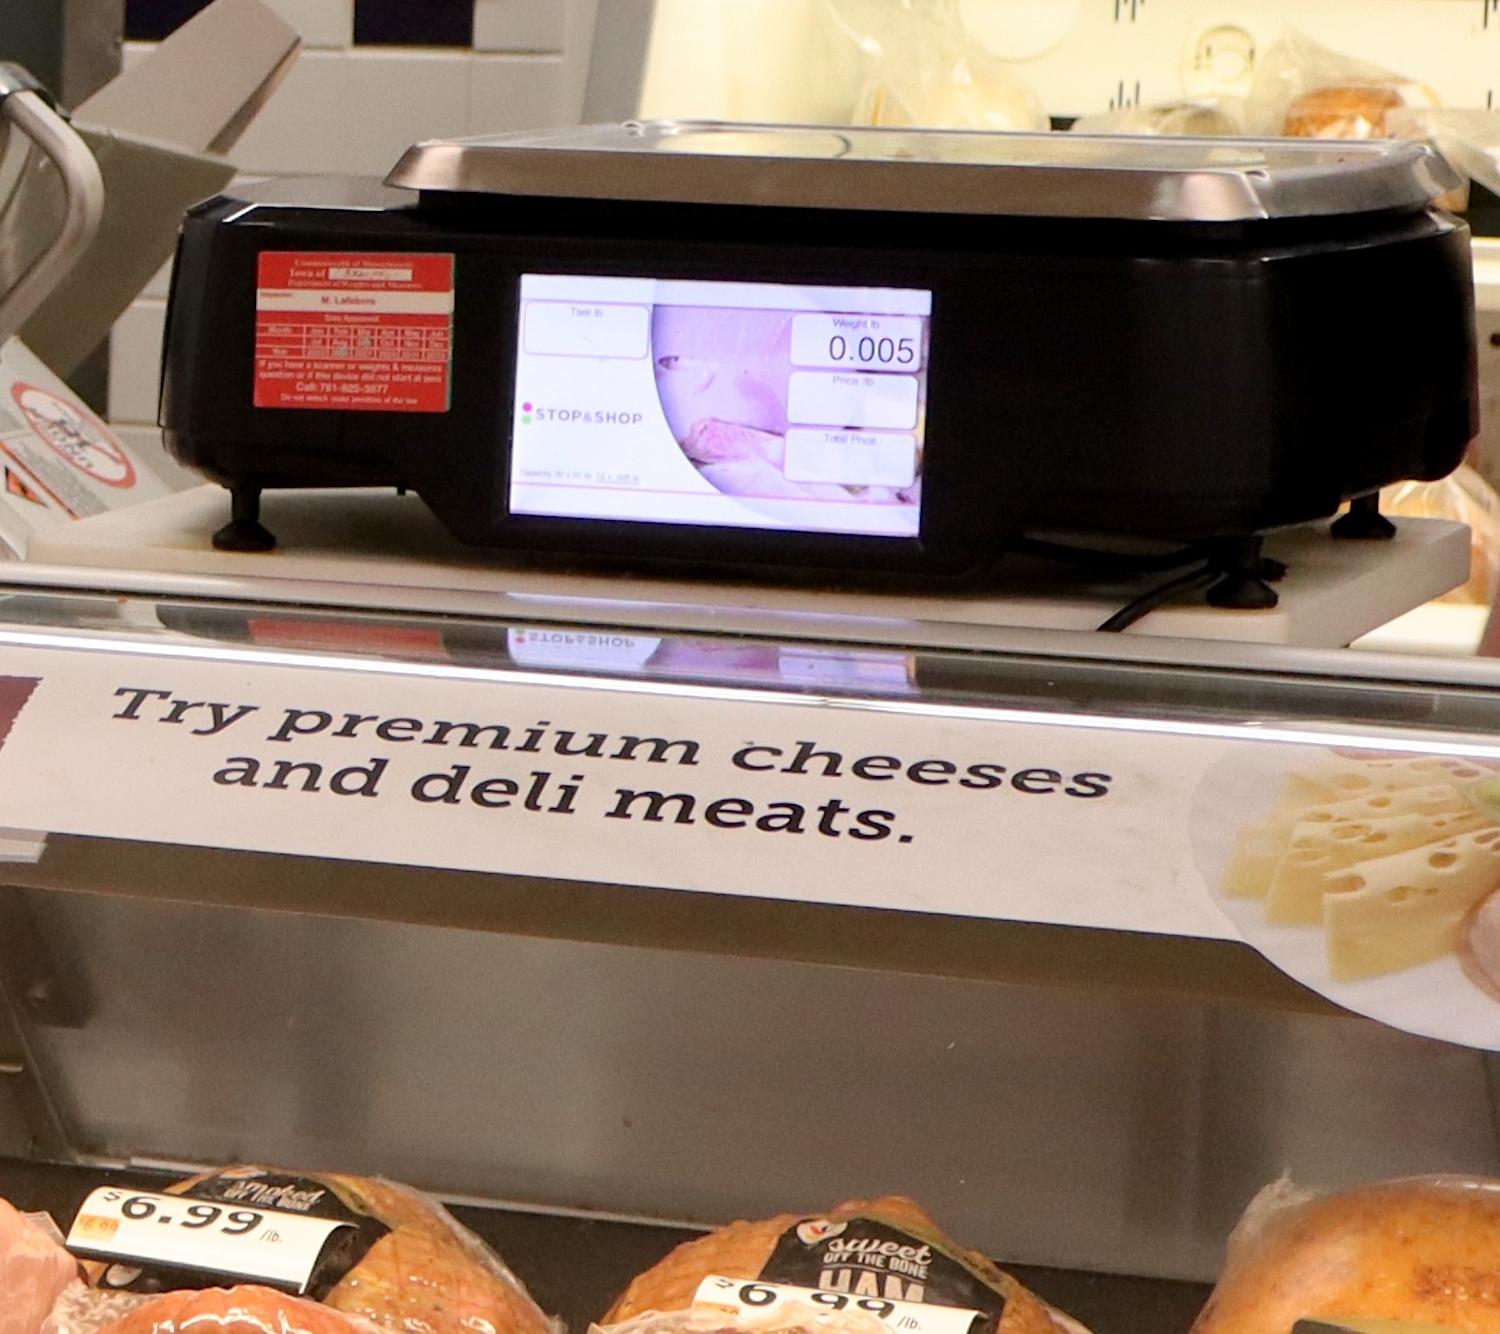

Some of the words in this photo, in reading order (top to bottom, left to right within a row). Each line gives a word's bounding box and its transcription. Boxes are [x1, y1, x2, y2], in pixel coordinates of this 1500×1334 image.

[832, 317, 867, 332] Weight
[828, 334, 916, 364] 0.005
[832, 374, 858, 387] Price
[535, 407, 643, 425] STOP&SHOP
[823, 432, 848, 445] Total
[850, 434, 878, 447] Price
[111, 687, 259, 738] Try
[268, 708, 701, 768] premium
[729, 737, 1116, 800] cheeses
[212, 755, 380, 798] and
[409, 762, 579, 815] deli
[604, 784, 915, 846] meats.
[101, 1190, 264, 1236] $6.99
[827, 1238, 932, 1267] sweet
[857, 1252, 886, 1268] THE
[888, 1255, 930, 1280] BONE
